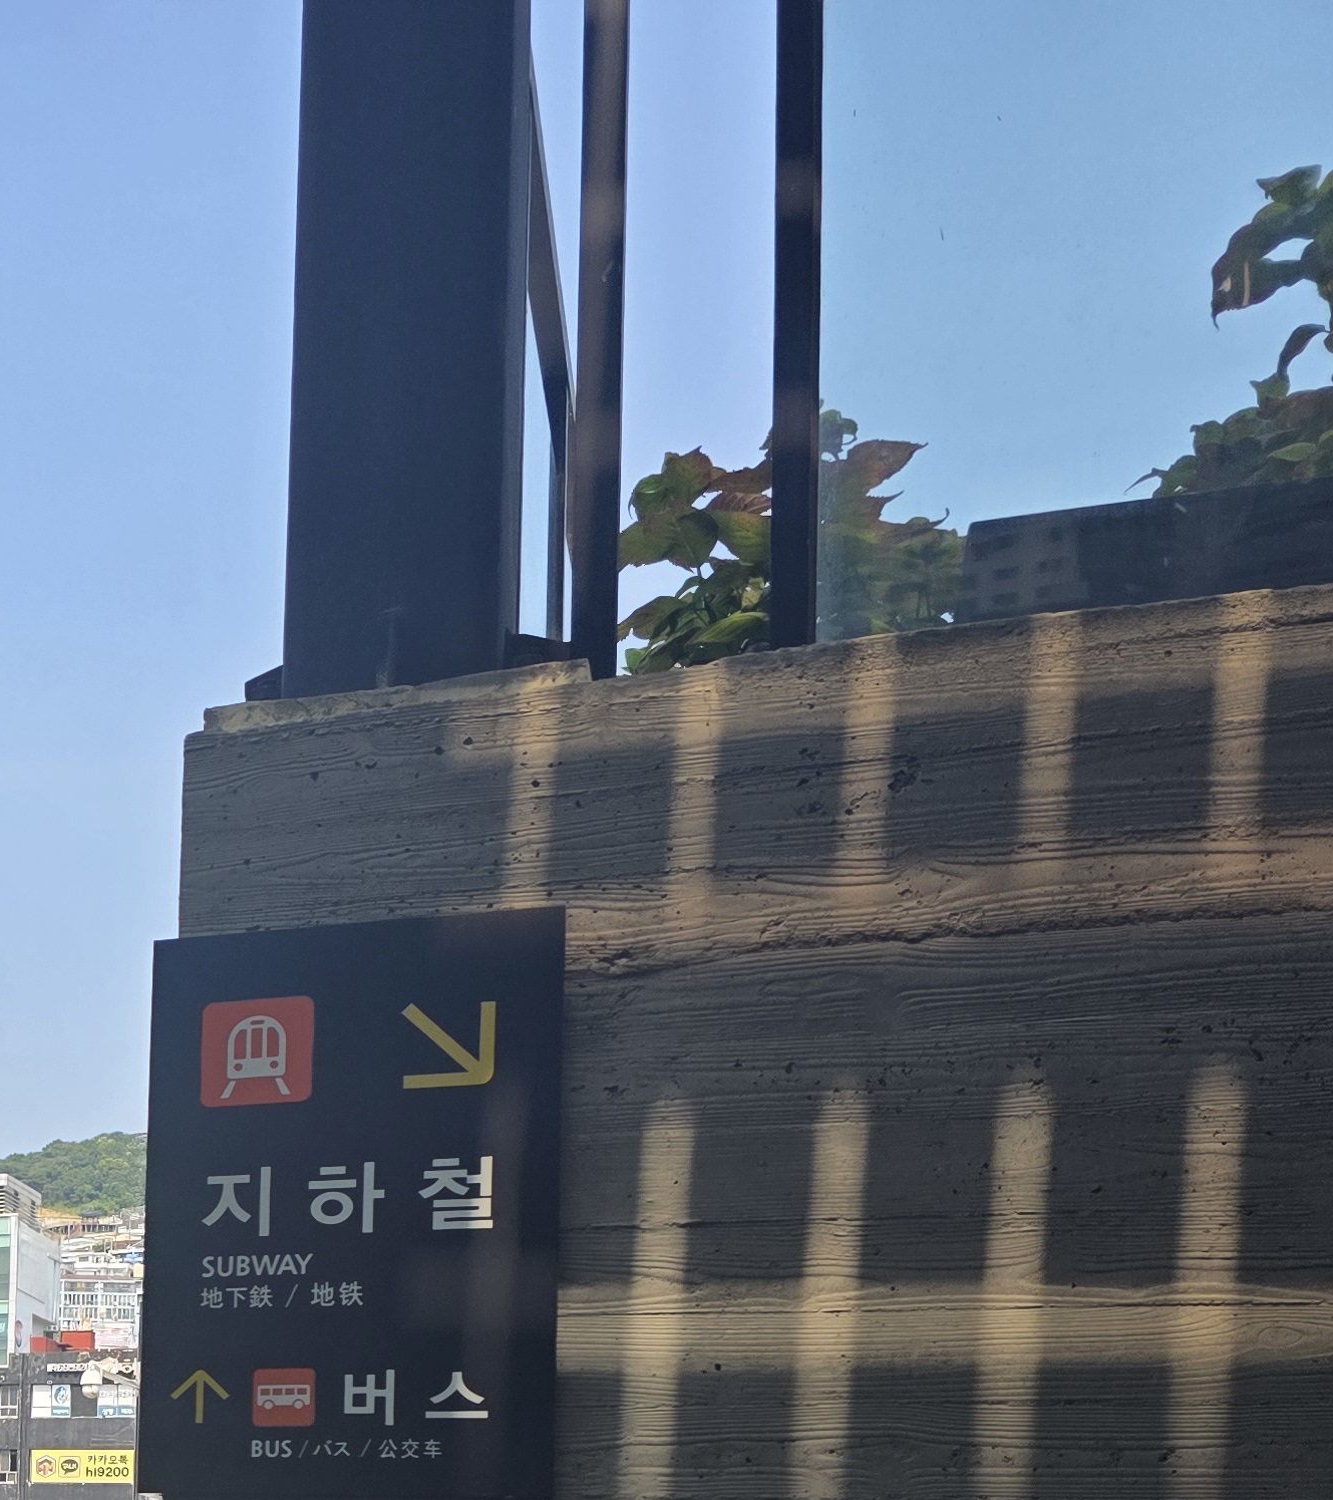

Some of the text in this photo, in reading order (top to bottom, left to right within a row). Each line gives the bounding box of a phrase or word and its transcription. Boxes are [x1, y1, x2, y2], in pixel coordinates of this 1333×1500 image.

[201, 1155, 494, 1237] 지하철
[201, 1253, 313, 1278] SUBWAY
[200, 1286, 273, 1309] 地下鉄
[311, 1281, 364, 1307] 地铁
[343, 1369, 489, 1426] 버스
[87, 1455, 129, 1466] 카카오톡
[251, 1440, 292, 1459] BUS
[313, 1439, 351, 1457] バス
[378, 1439, 443, 1459] 公交车
